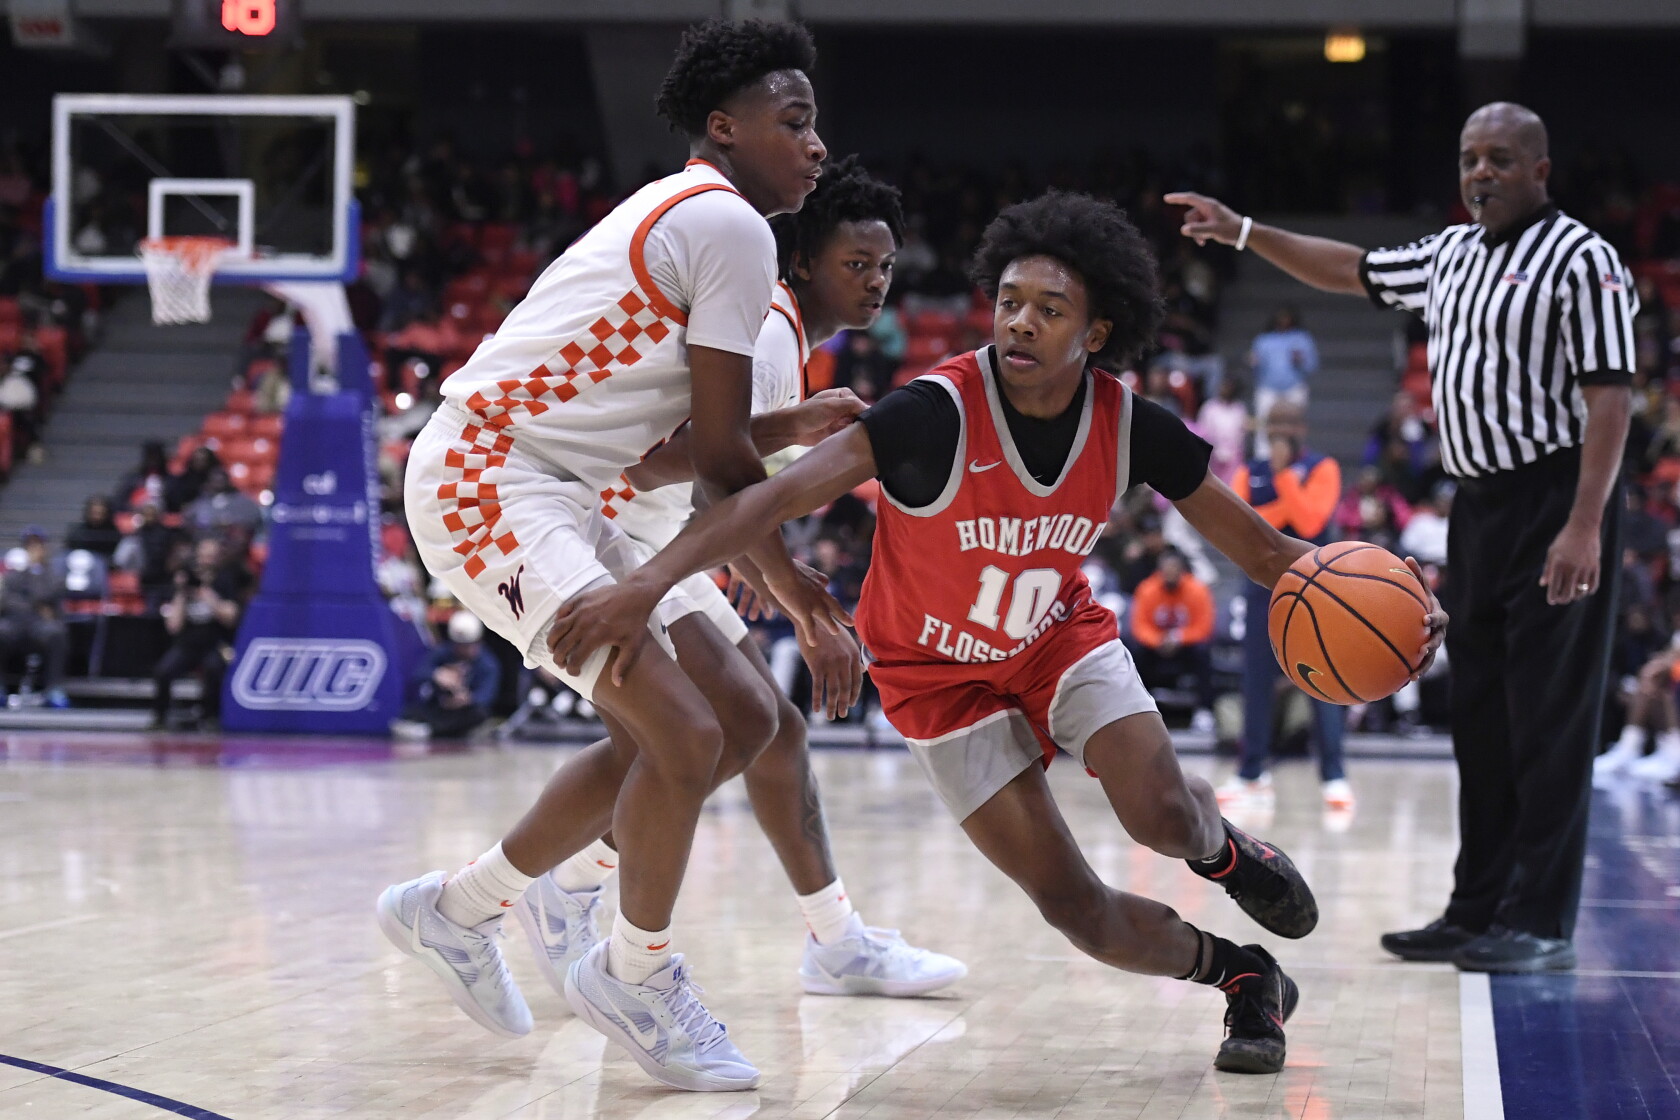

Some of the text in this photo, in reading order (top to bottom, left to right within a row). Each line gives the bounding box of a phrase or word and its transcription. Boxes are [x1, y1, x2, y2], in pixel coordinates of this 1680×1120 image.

[954, 513, 1108, 557] HOMEWOOD
[966, 564, 1063, 640] 10
[233, 640, 386, 709] UIC
